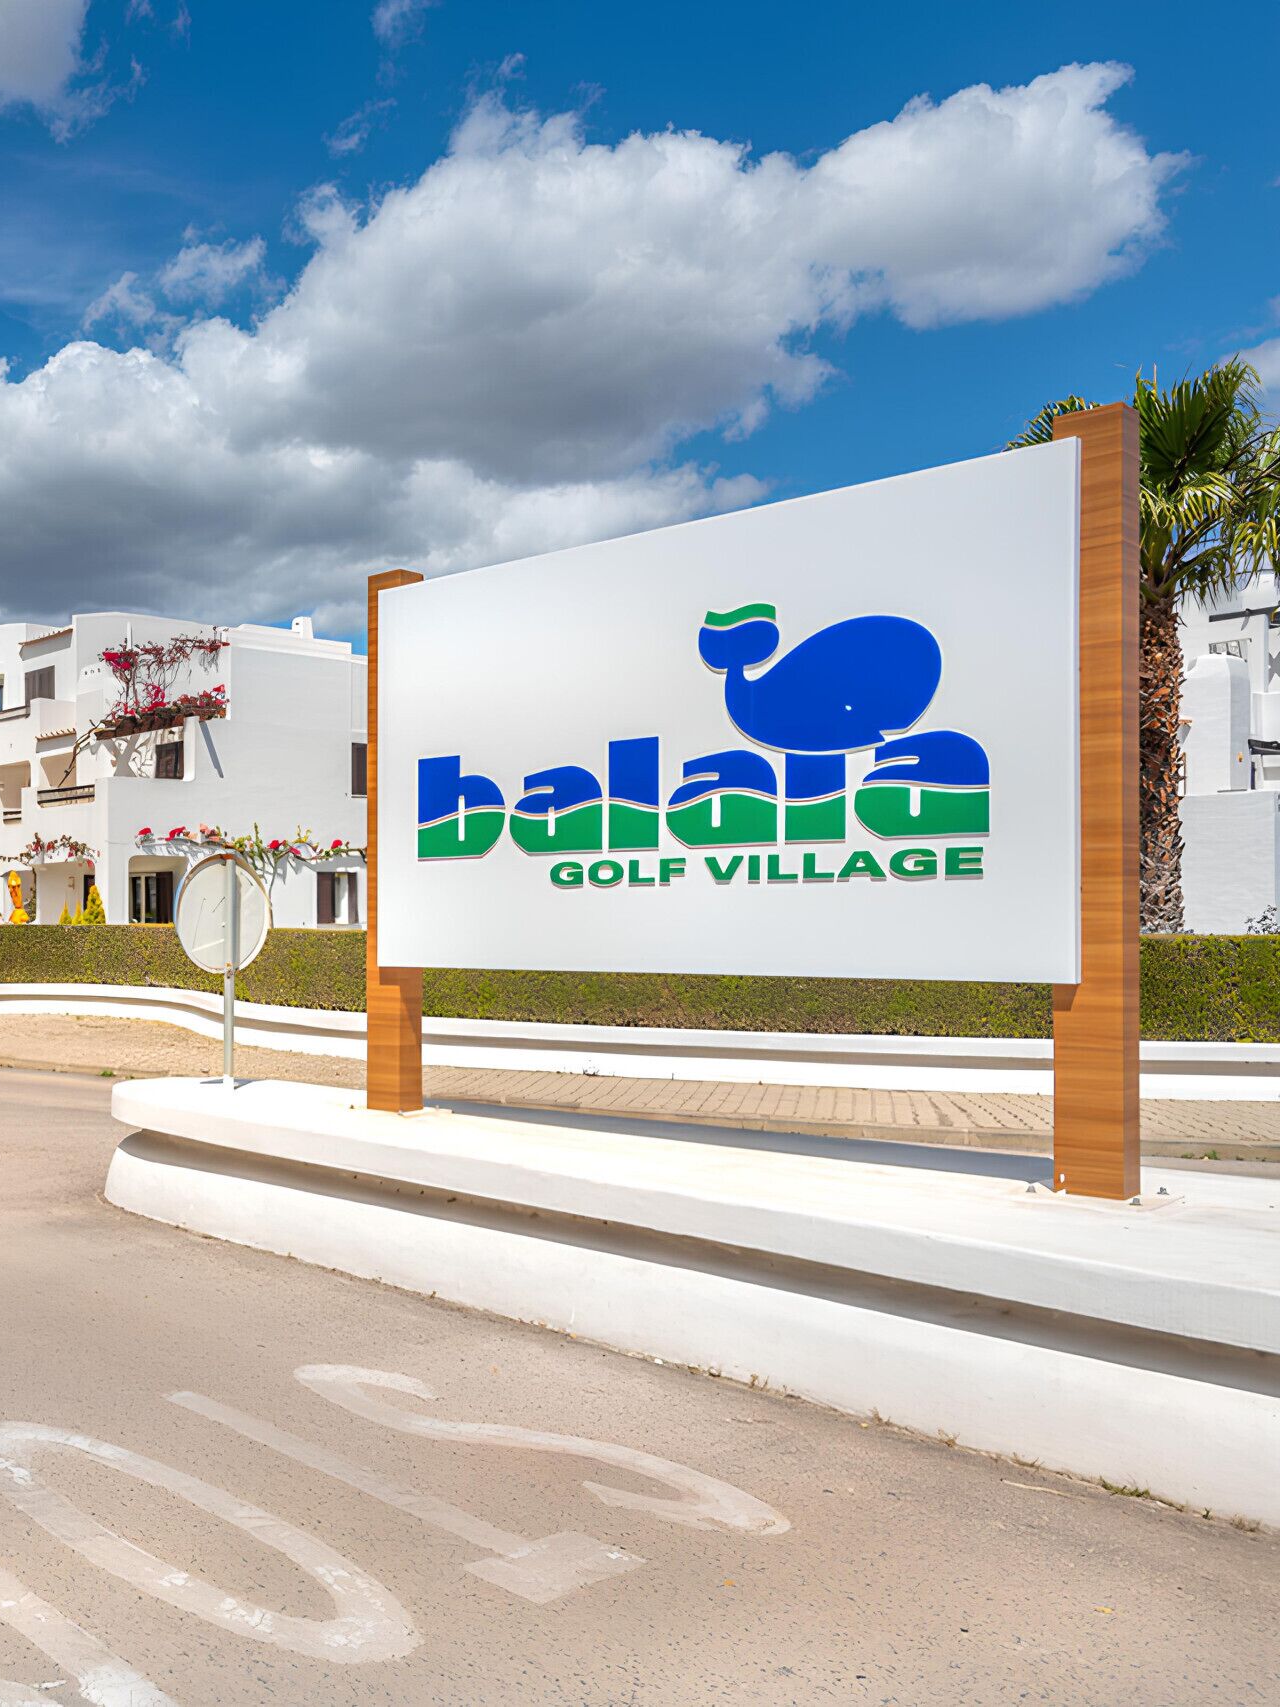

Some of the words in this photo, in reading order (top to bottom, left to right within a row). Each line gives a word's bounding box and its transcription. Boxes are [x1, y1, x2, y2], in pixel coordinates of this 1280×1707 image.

[417, 730, 990, 861] balaia
[549, 857, 687, 888] GOLF
[703, 846, 985, 885] VILLAGE
